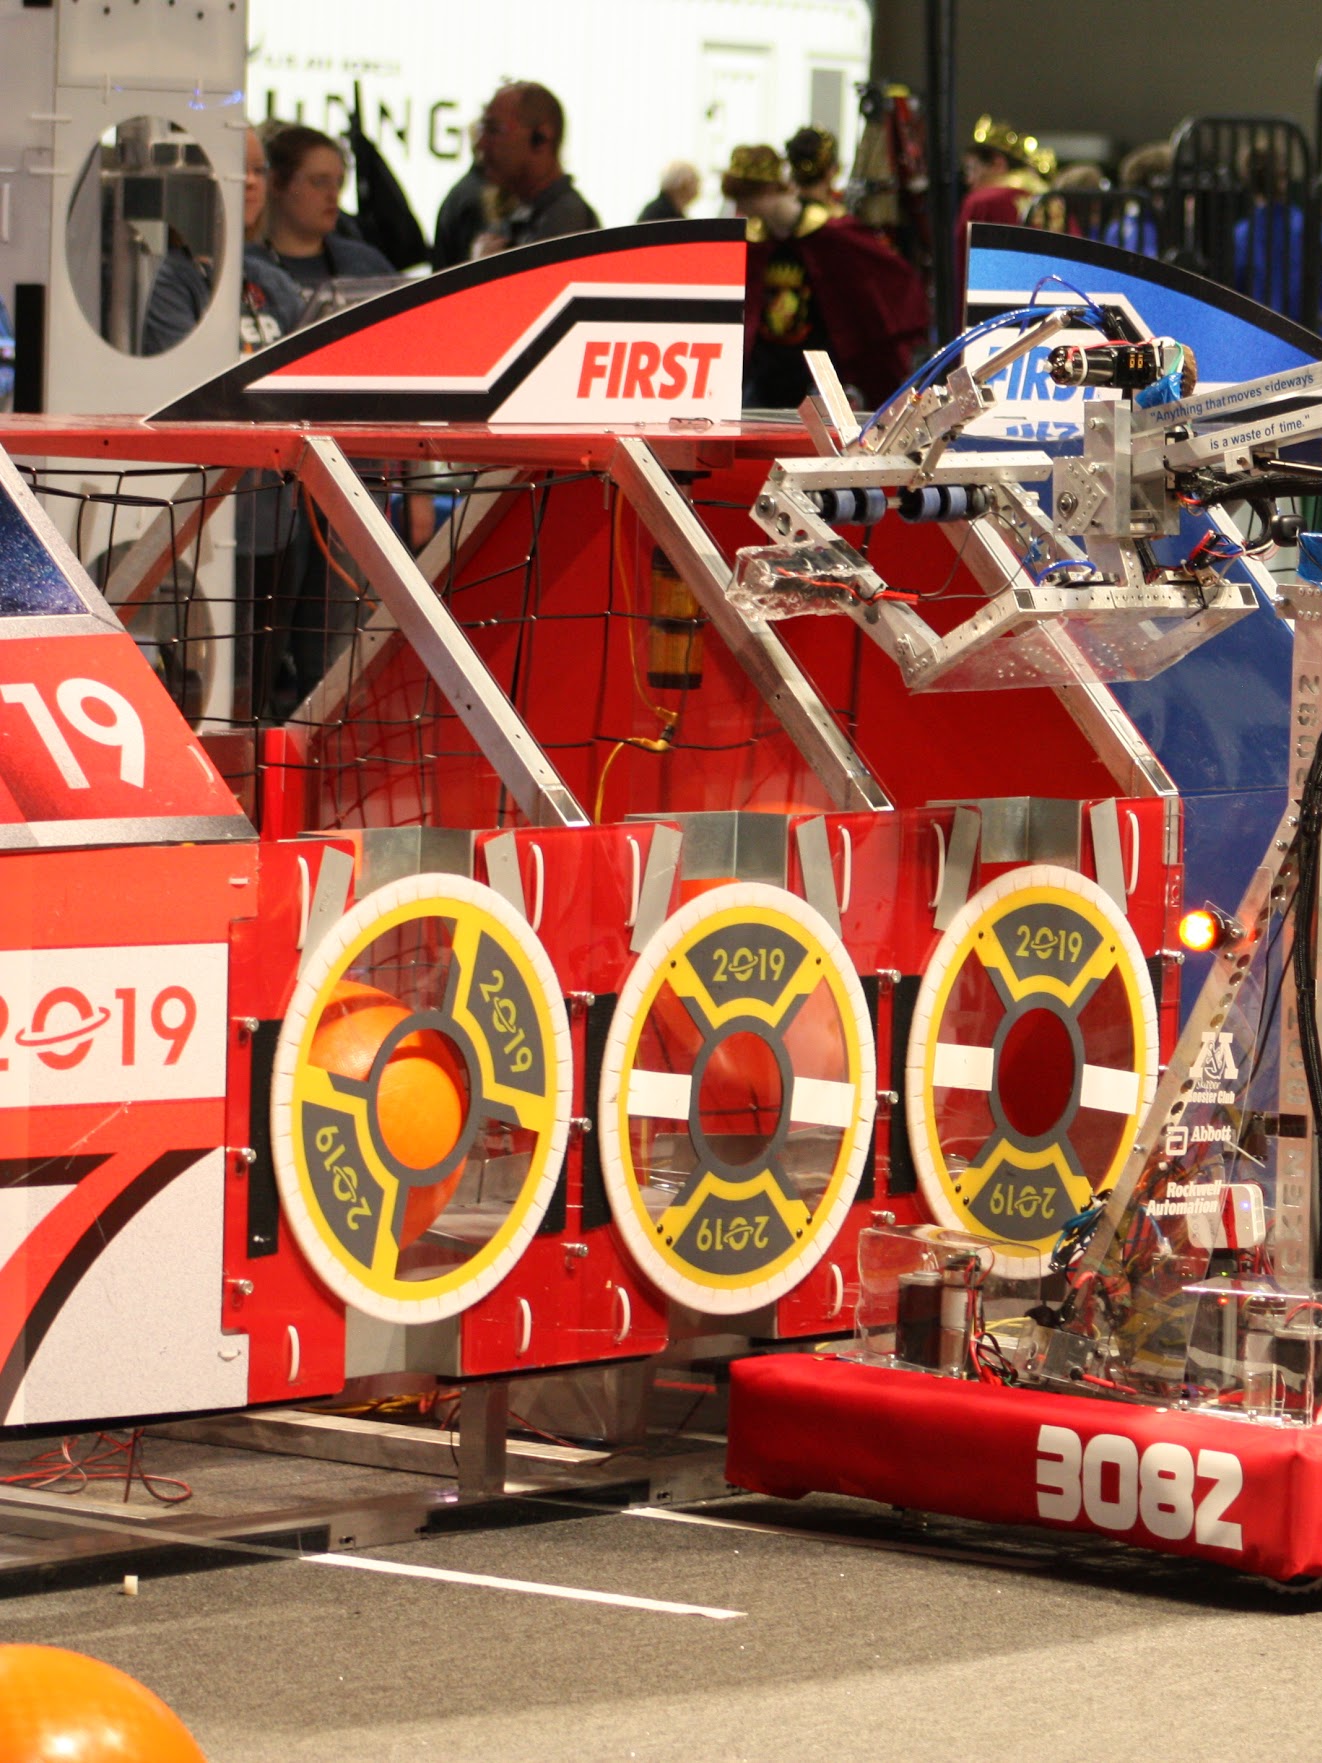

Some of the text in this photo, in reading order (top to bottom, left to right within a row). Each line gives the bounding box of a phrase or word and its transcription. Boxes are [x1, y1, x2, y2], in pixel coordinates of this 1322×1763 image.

[576, 340, 724, 400] FIRST
[1205, 396, 1227, 410] that
[1227, 388, 1263, 405] moves
[1210, 438, 1219, 450] is
[1222, 435, 1229, 447] a
[1231, 427, 1262, 445] waste
[1264, 423, 1275, 436] of
[1015, 924, 1084, 963] 2019
[712, 946, 786, 982] 2019
[479, 969, 534, 1073] 2019
[1217, 1090, 1236, 1105] Club
[1190, 1123, 1232, 1142] Abbott
[315, 1125, 373, 1231] 2019
[1166, 1180, 1222, 1198] Rockwell
[989, 1183, 1058, 1220] 2019
[1145, 1198, 1219, 1217] Automation
[696, 1215, 771, 1251] 2019
[1035, 1424, 1244, 1552] 3082
